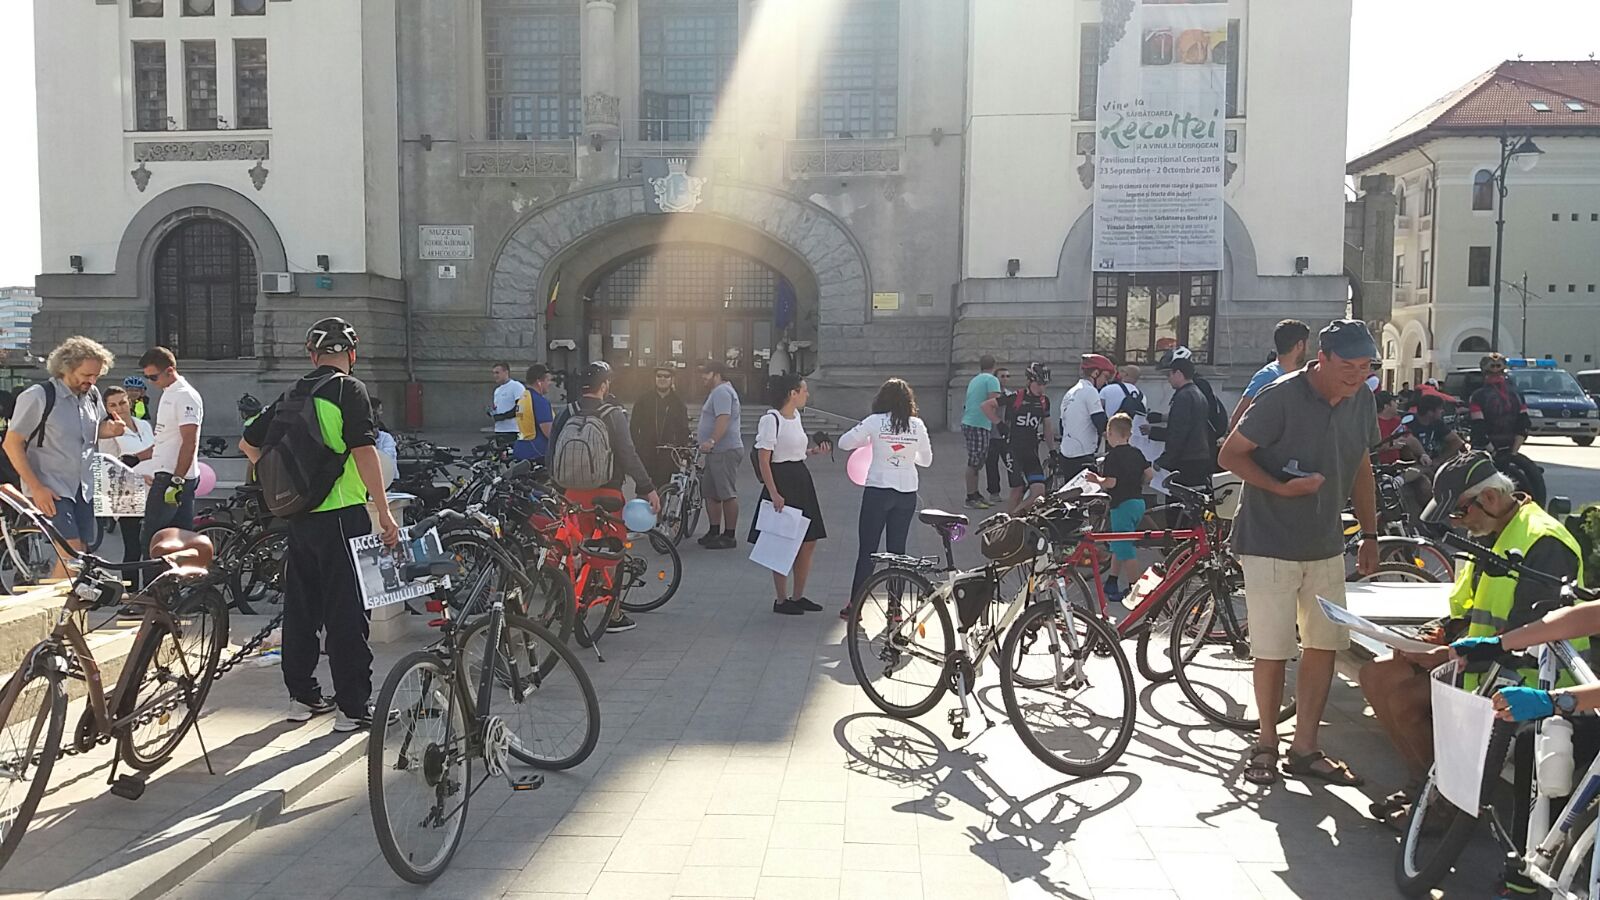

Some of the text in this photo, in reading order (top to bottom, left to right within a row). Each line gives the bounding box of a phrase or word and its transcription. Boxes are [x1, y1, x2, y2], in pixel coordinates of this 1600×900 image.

[1103, 98, 1145, 111] Vine la
[1100, 109, 1219, 149] Recoltei
[1100, 156, 1136, 164] Pavilionul
[1100, 167, 1108, 175] 23
[1110, 166, 1151, 175] Septembrie
[1162, 166, 1200, 174] Octombrie
[429, 228, 463, 236] MUZEUL
[1016, 412, 1039, 429] sky
